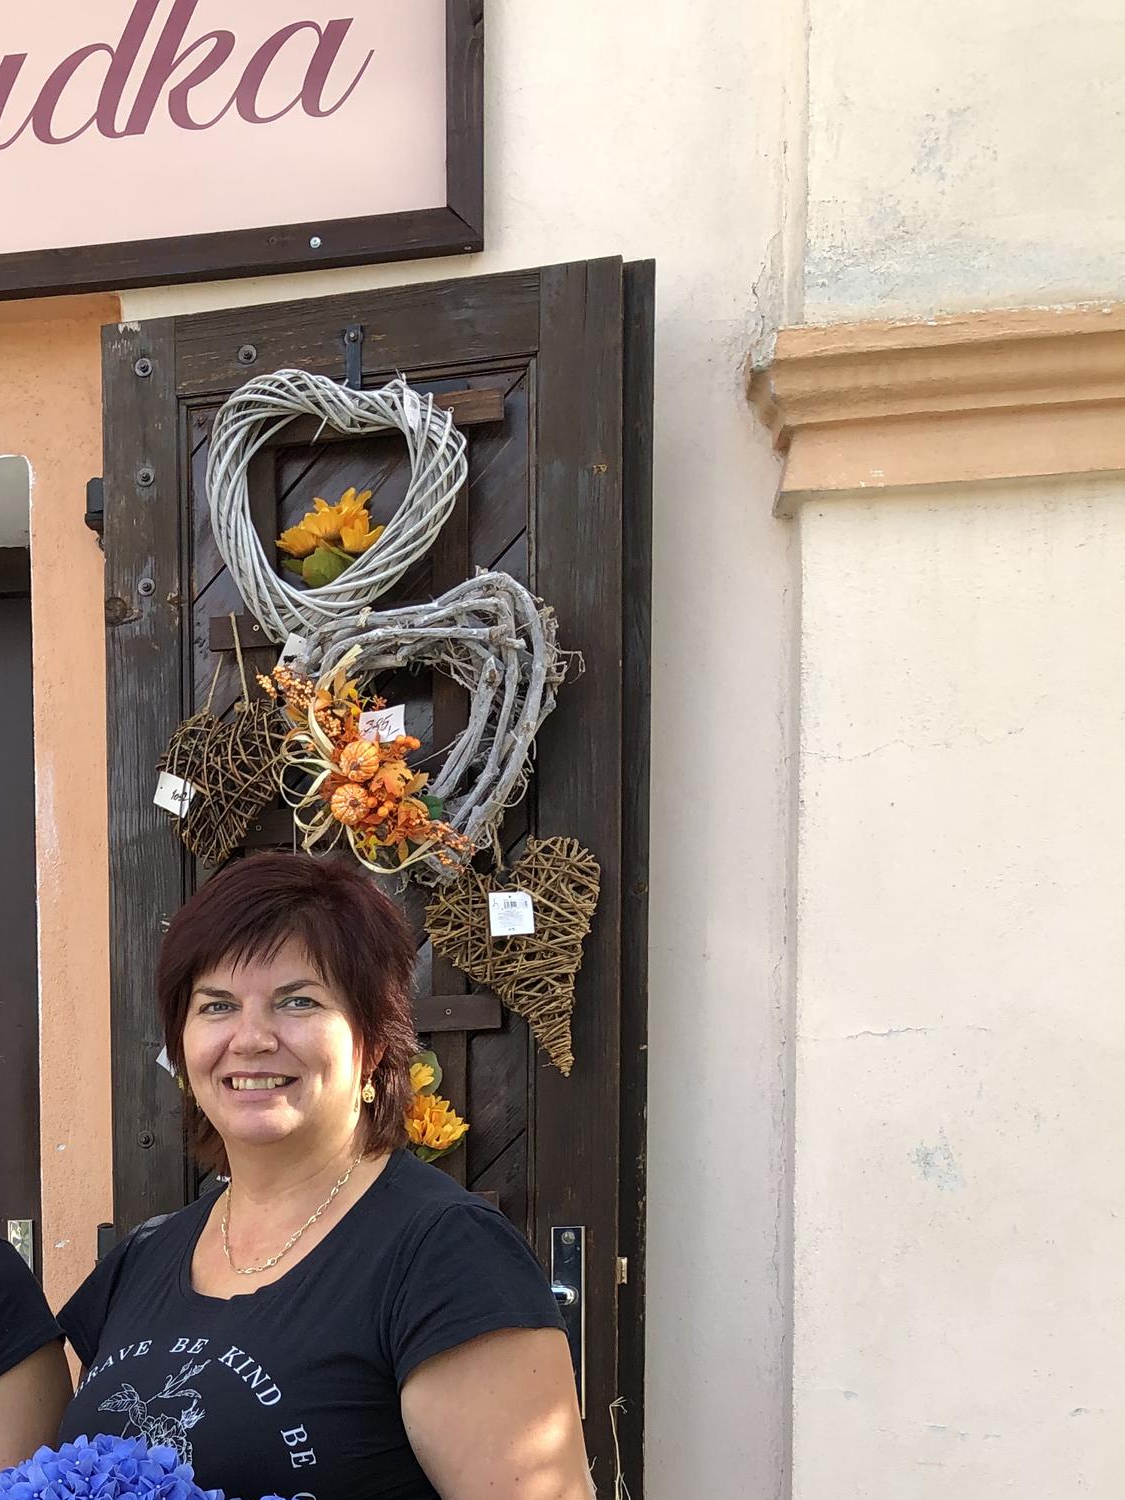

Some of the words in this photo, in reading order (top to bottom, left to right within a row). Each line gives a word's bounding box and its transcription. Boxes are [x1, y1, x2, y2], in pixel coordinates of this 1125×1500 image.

[169, 1337, 210, 1355] BE
[217, 1345, 283, 1407] KIND
[280, 1423, 318, 1470] BE
